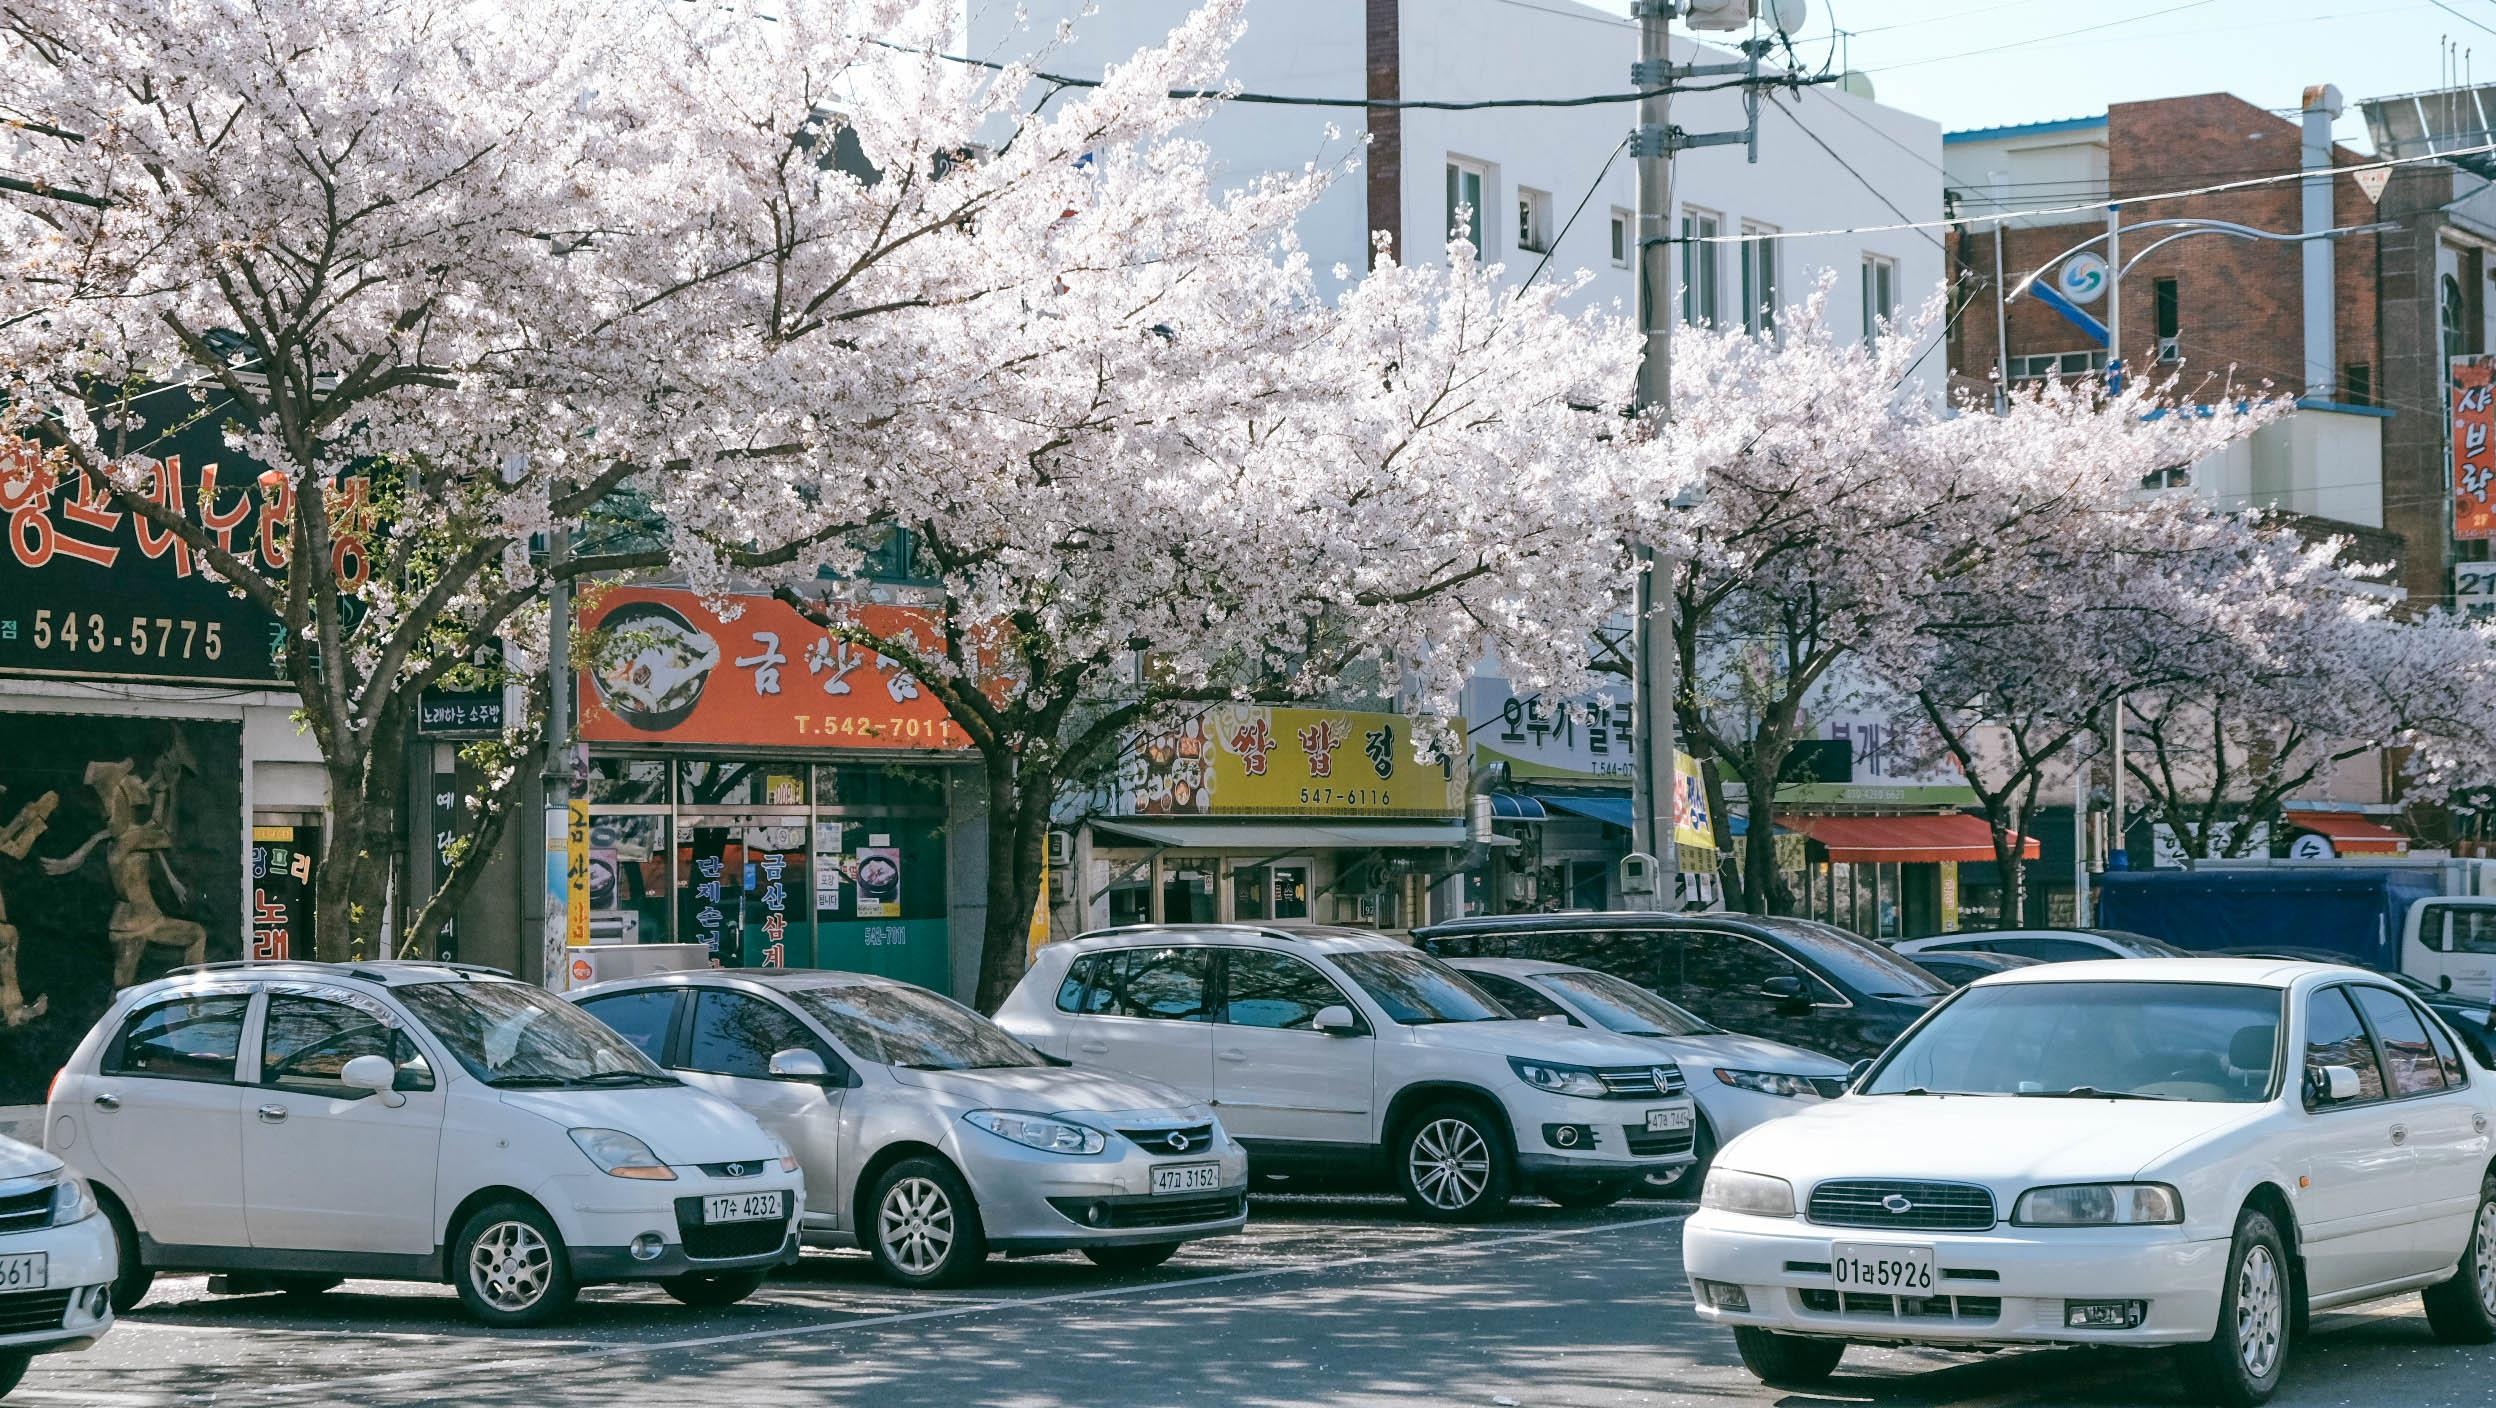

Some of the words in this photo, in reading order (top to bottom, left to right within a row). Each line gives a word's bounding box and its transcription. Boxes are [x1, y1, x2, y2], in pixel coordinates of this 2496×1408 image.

[423, 706, 466, 725] 노래하는
[469, 704, 500, 724] 소주방
[1299, 787, 1391, 806] 547-6116
[1186, 1168, 1213, 1188] 3152
[712, 1199, 738, 1219] 17수
[743, 1194, 776, 1216] 4232
